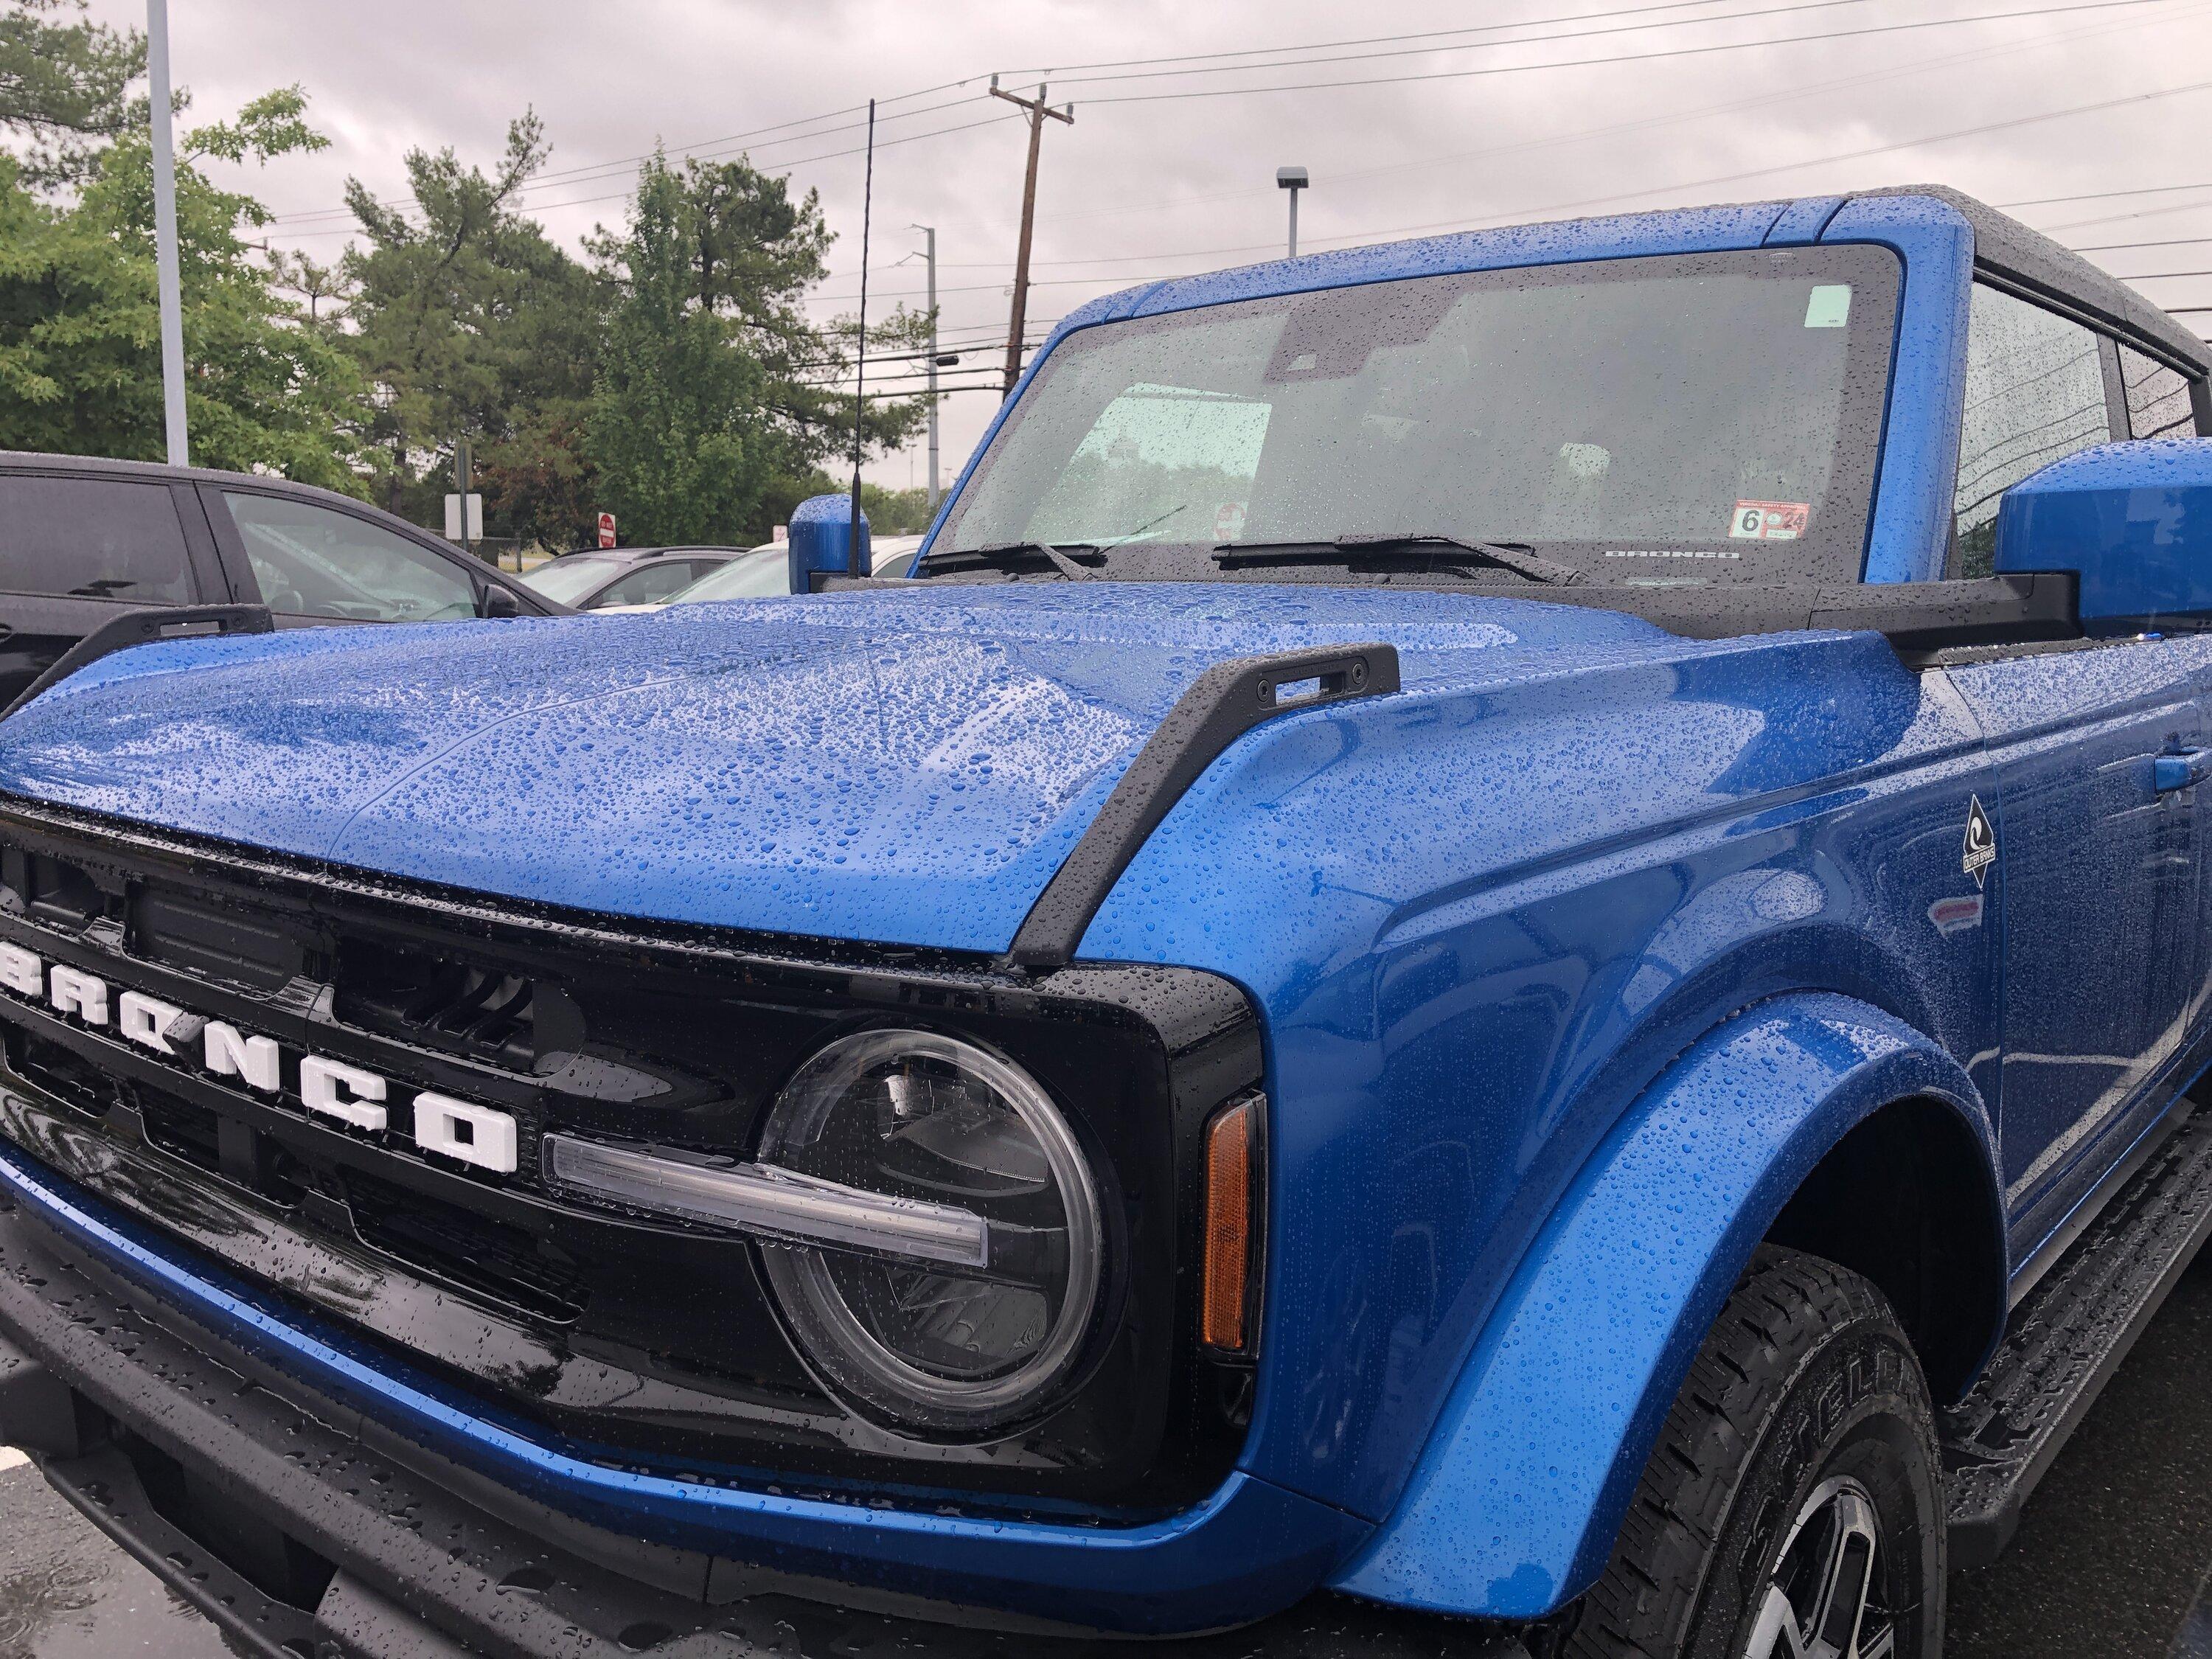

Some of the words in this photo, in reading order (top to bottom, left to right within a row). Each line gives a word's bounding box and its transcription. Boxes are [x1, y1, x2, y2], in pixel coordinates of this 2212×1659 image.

[1742, 509, 1760, 532] 6
[1964, 853, 1980, 870] OUTER
[1979, 847, 1994, 863] BANKS
[0, 941, 518, 1173] BRONCO
